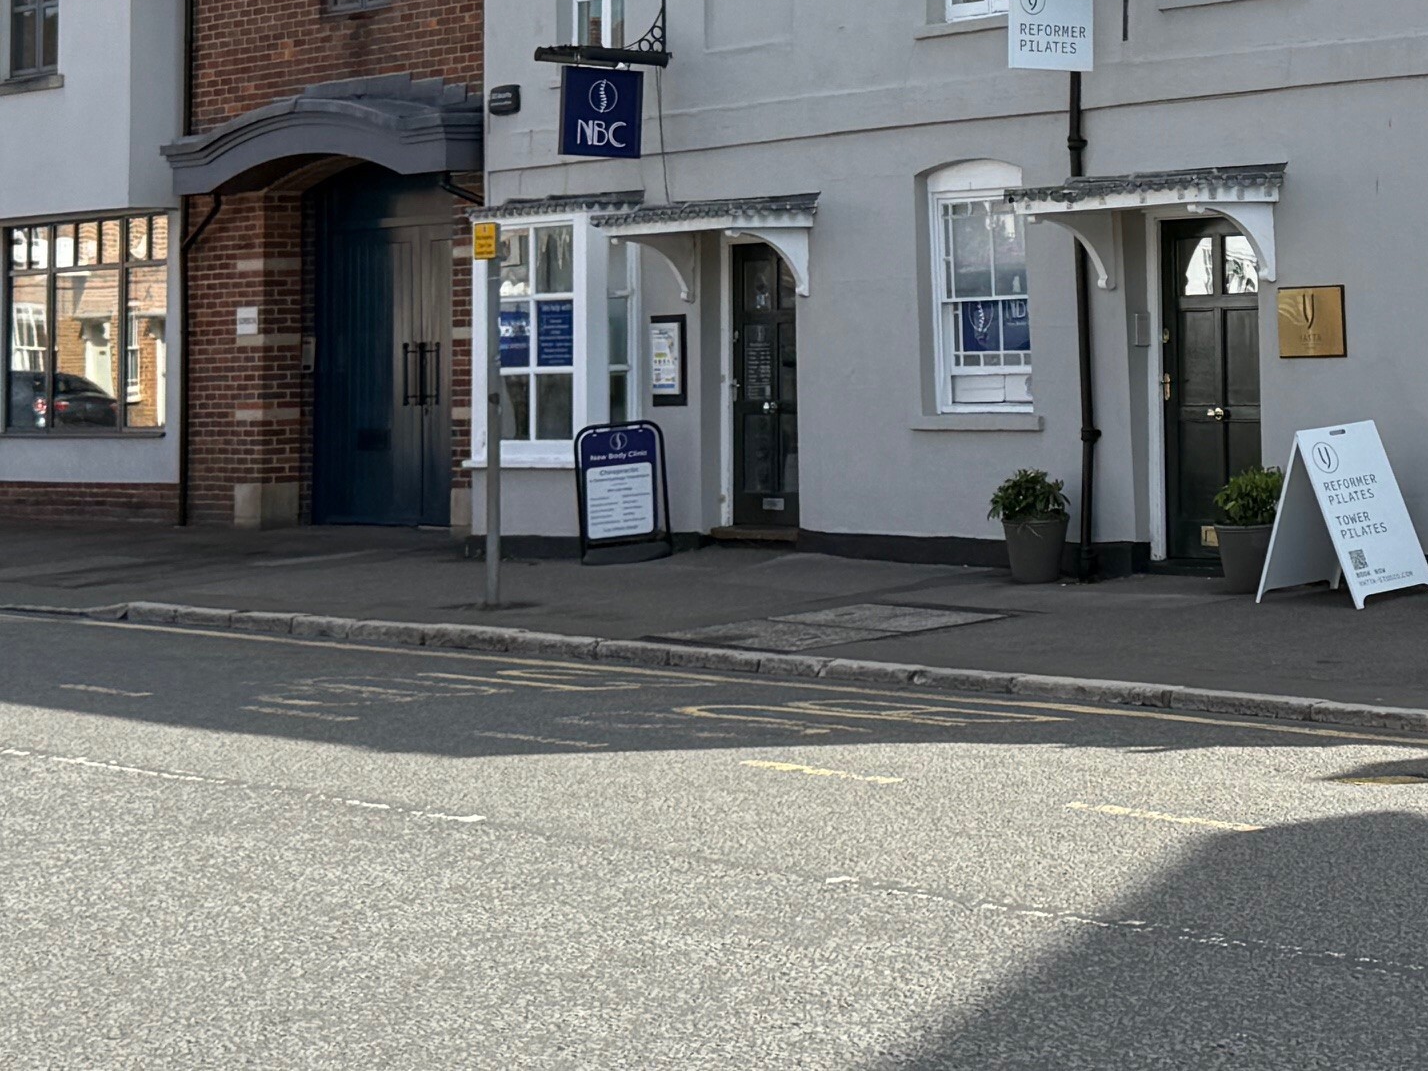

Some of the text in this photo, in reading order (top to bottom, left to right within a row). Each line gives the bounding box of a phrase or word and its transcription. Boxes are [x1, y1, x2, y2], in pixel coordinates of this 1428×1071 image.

[1020, 23, 1086, 39] REFORMER
[1020, 39, 1077, 54] PILATES
[577, 119, 627, 148] NBC
[608, 452, 626, 460] Body
[1323, 474, 1378, 492] REFORMER
[1328, 488, 1375, 506] PILATES
[1335, 511, 1371, 526] TOWER
[1340, 522, 1388, 539] PILATES
